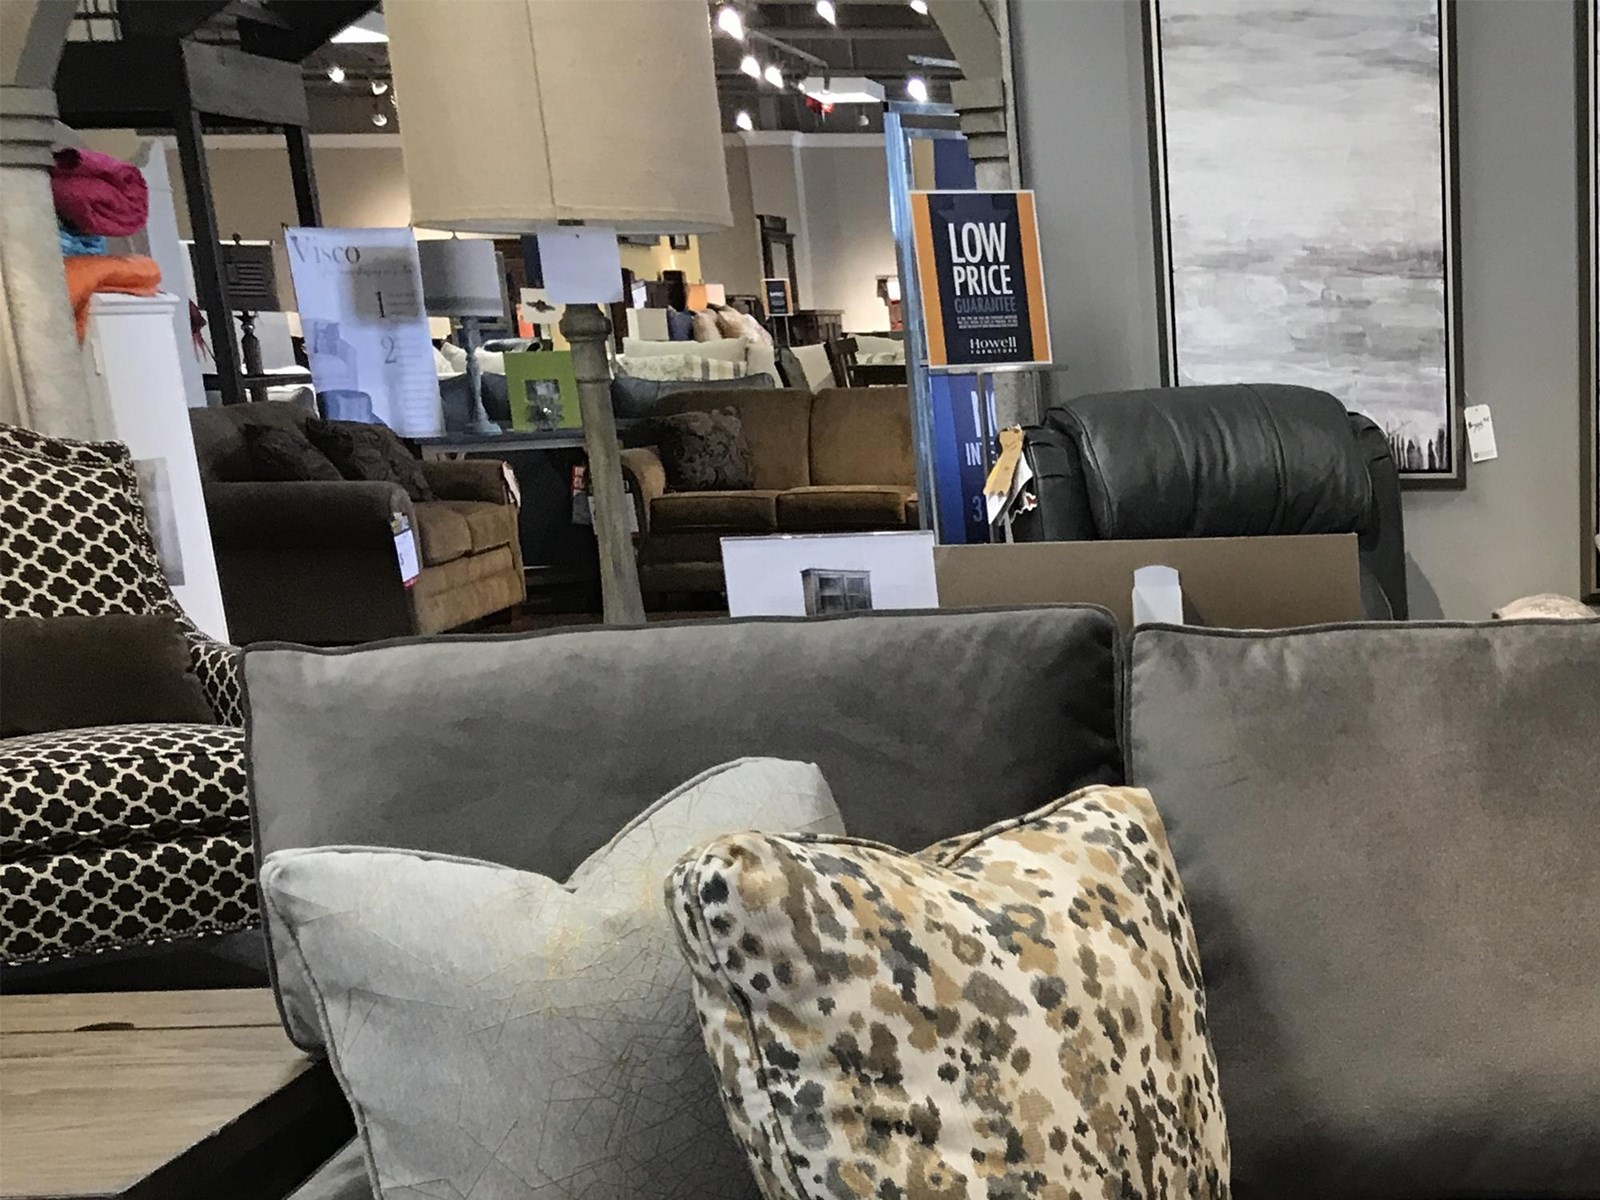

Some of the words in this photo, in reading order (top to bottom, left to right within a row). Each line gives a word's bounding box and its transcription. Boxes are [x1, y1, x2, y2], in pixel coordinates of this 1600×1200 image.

[947, 221, 1007, 264] LOW
[952, 264, 1014, 296] PRICE
[954, 296, 1017, 314] GUARANTEE
[970, 336, 1017, 349] Howell
